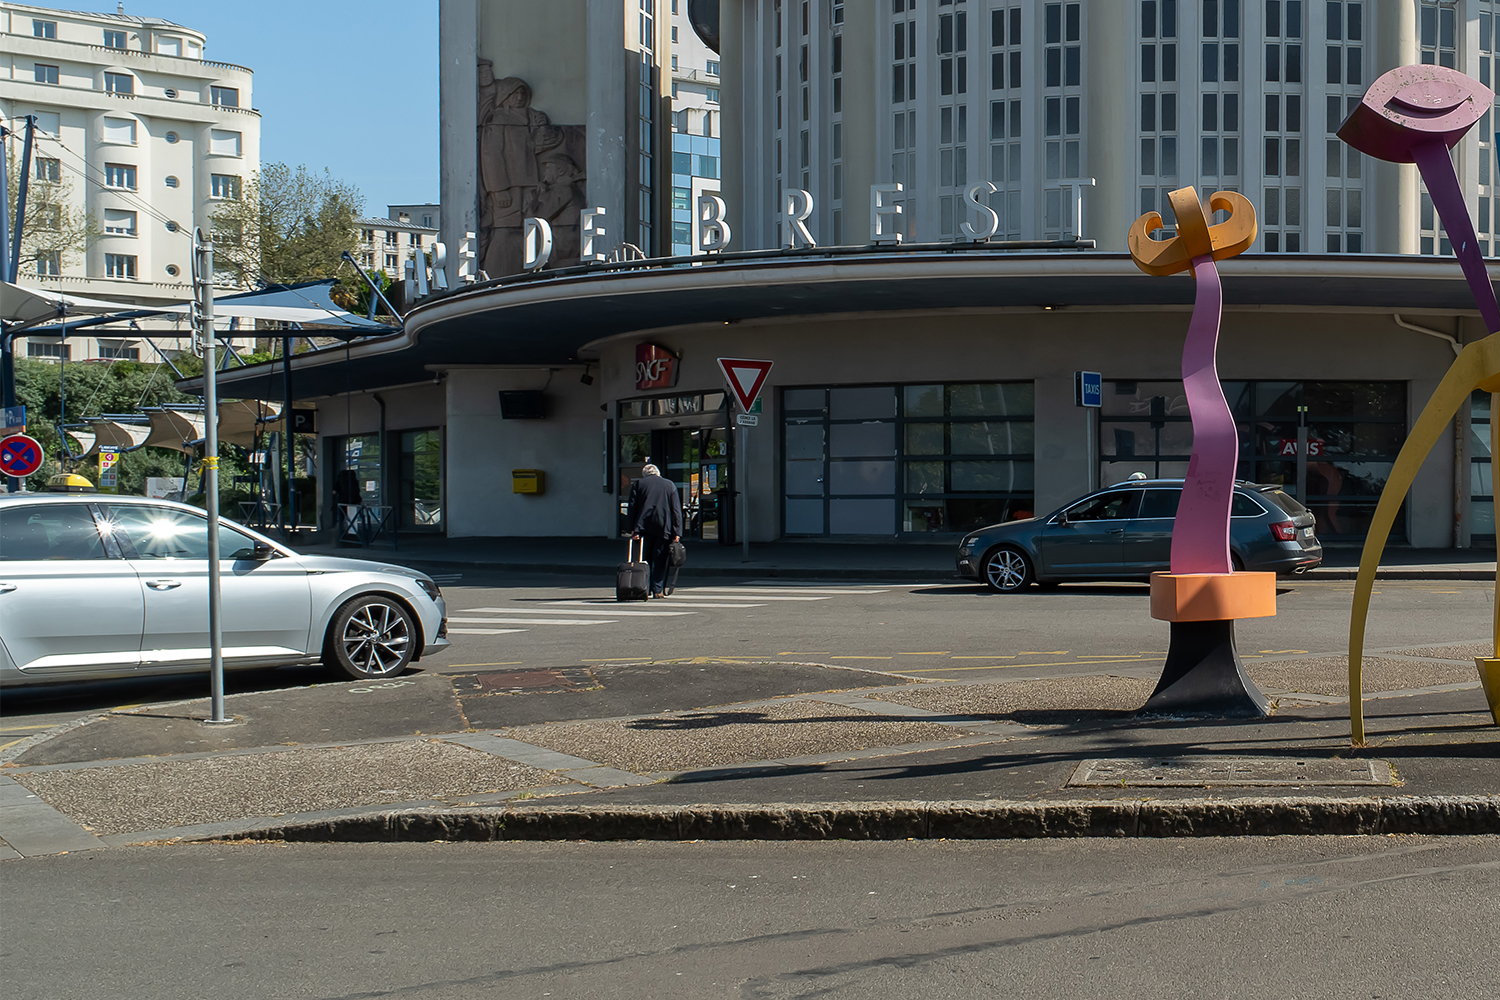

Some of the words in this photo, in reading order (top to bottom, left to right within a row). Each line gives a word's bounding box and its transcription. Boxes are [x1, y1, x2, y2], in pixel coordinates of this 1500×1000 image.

[523, 206, 606, 270] DE
[699, 177, 1096, 251] BREST
[636, 358, 670, 383] SNCF
[1084, 383, 1100, 395] TAXIS
[295, 414, 306, 428] P
